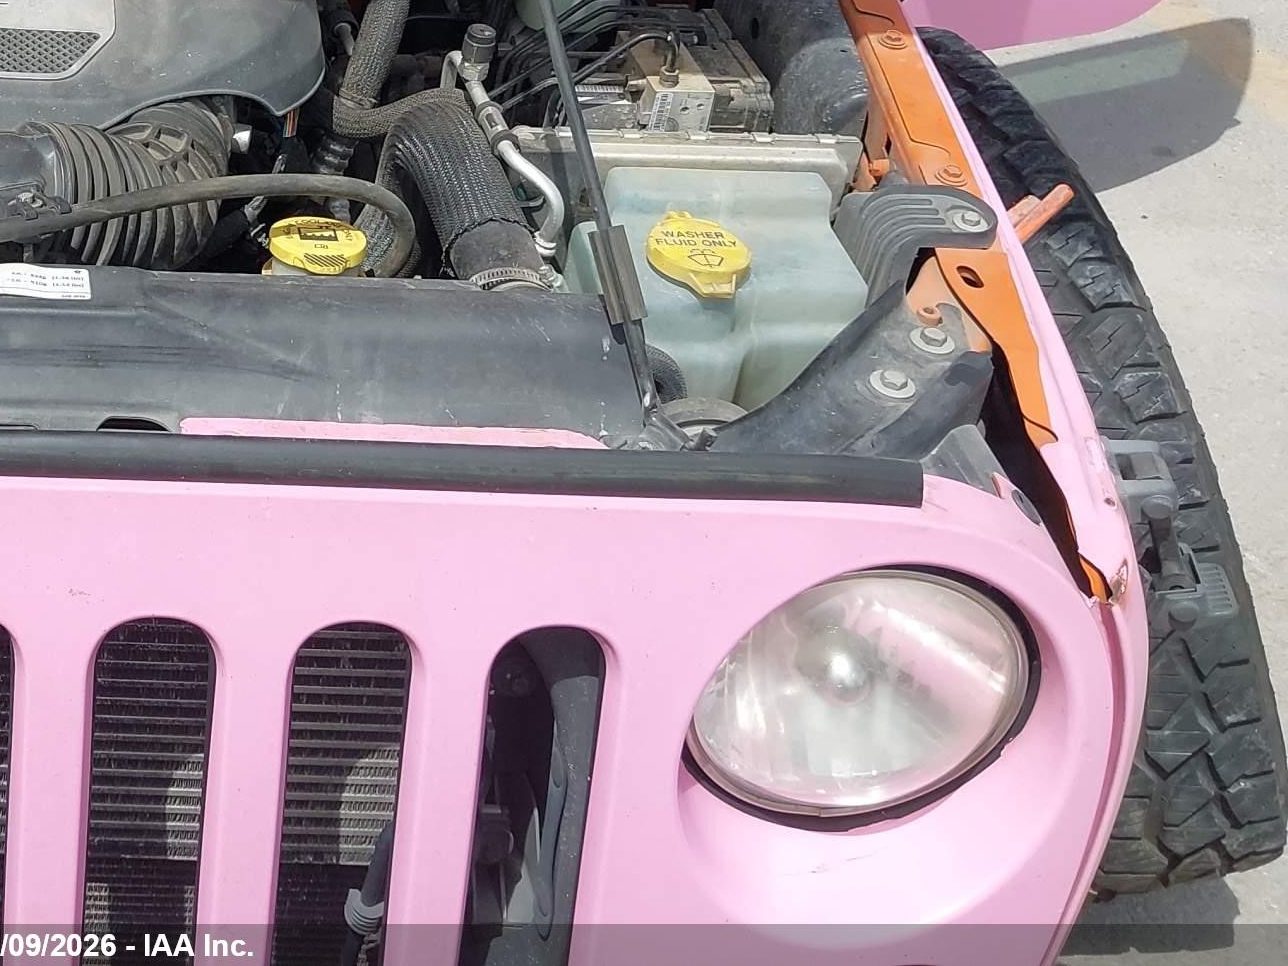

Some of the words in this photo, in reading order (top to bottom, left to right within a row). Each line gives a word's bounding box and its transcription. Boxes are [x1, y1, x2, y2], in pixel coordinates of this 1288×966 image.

[661, 230, 725, 239] WASHER
[655, 238, 697, 247] FLUID
[701, 238, 737, 248] ONLY
